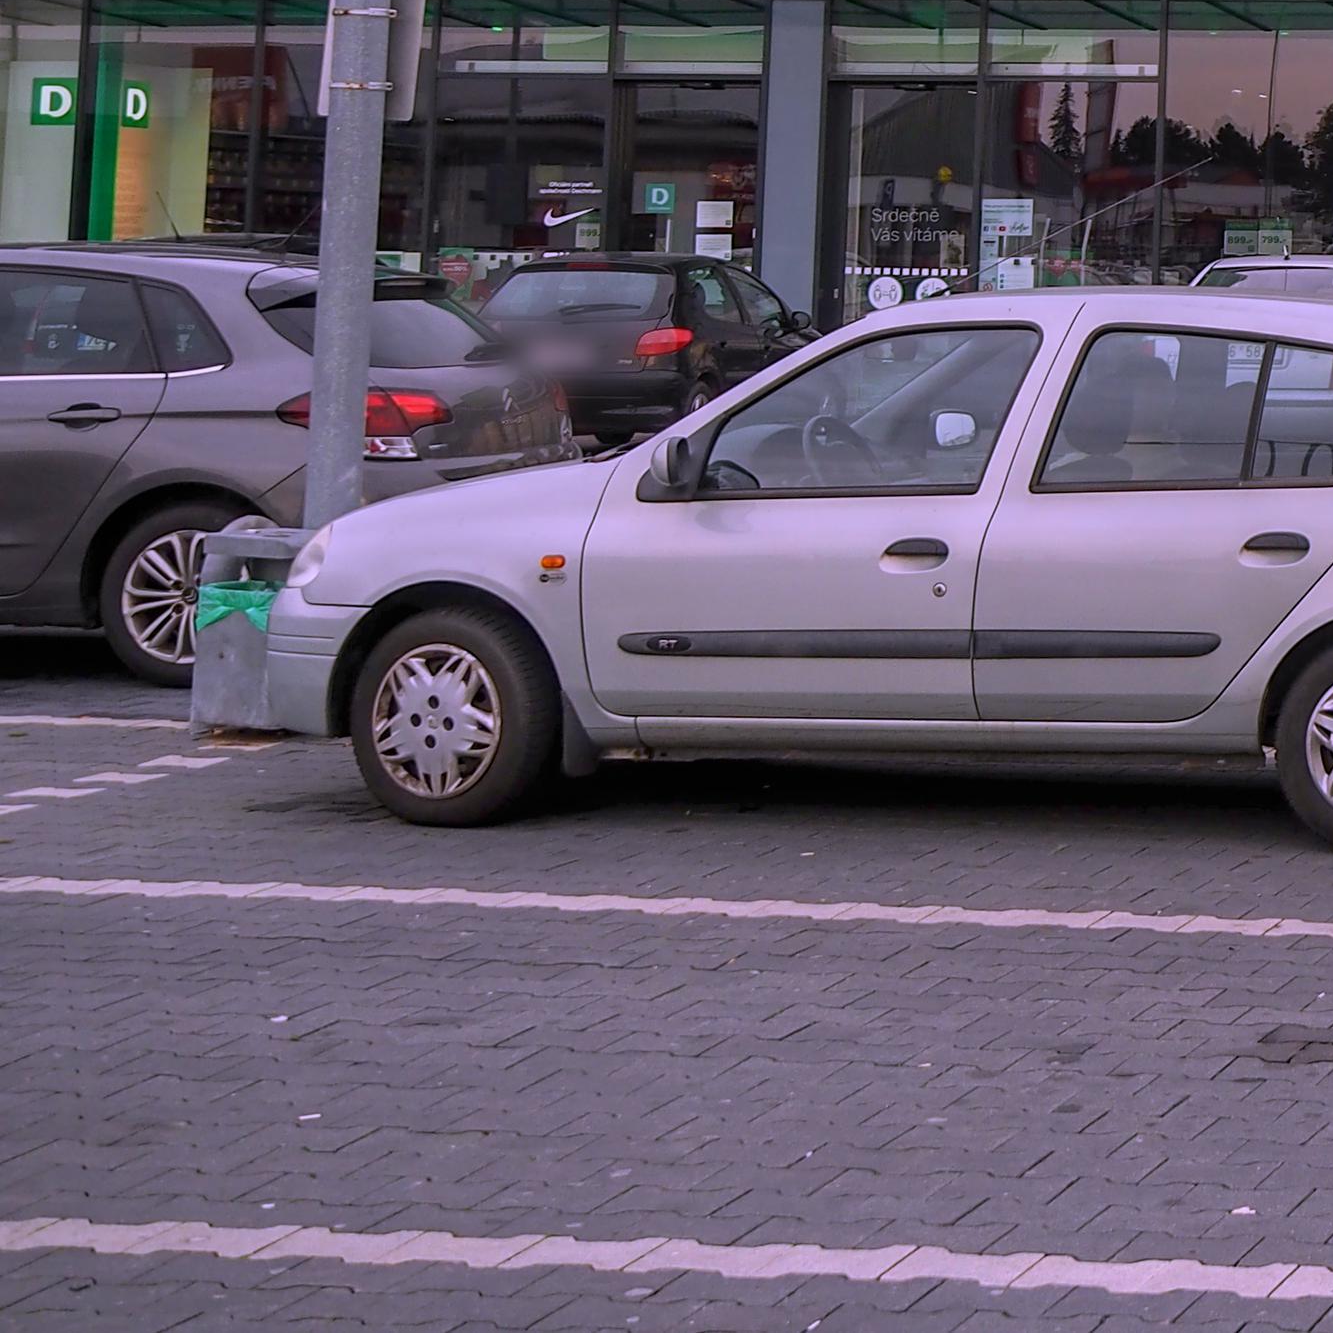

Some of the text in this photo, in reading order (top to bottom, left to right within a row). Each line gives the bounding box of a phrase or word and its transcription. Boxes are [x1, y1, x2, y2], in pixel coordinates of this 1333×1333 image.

[39, 84, 73, 118] D
[126, 87, 149, 121] D
[652, 187, 670, 205] D
[871, 207, 941, 223] Srdečně
[871, 227, 960, 243] Vás vítáme
[658, 639, 678, 649] RT
